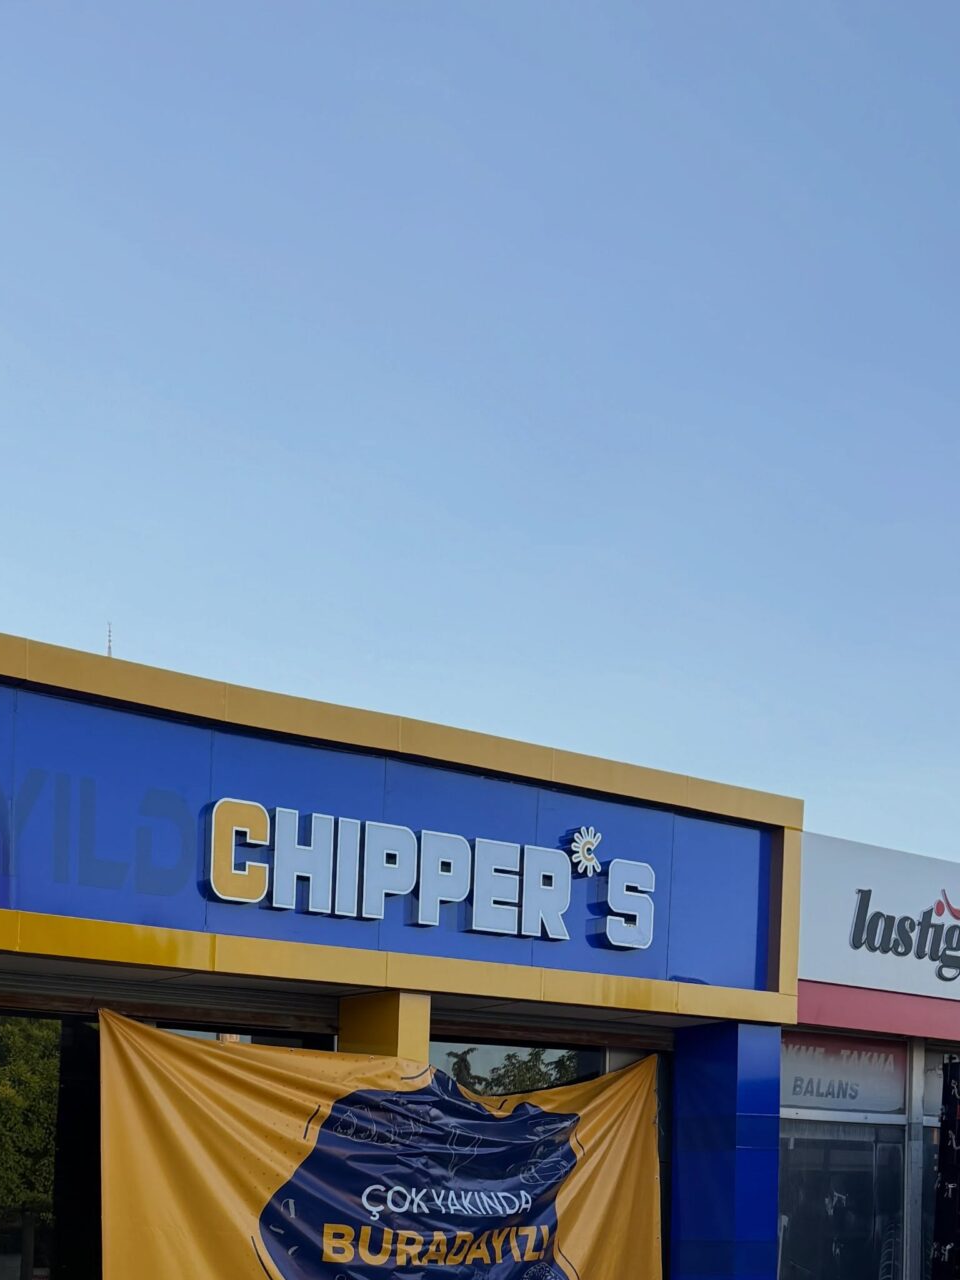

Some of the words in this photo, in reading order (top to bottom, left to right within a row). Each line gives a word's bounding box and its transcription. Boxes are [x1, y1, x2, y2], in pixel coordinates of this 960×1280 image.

[791, 1075, 860, 1100] BALANS
[361, 1184, 430, 1221] ÇOK
[431, 1189, 533, 1216] YAKINDA
[321, 1222, 550, 1267] BURADAYIZ!
